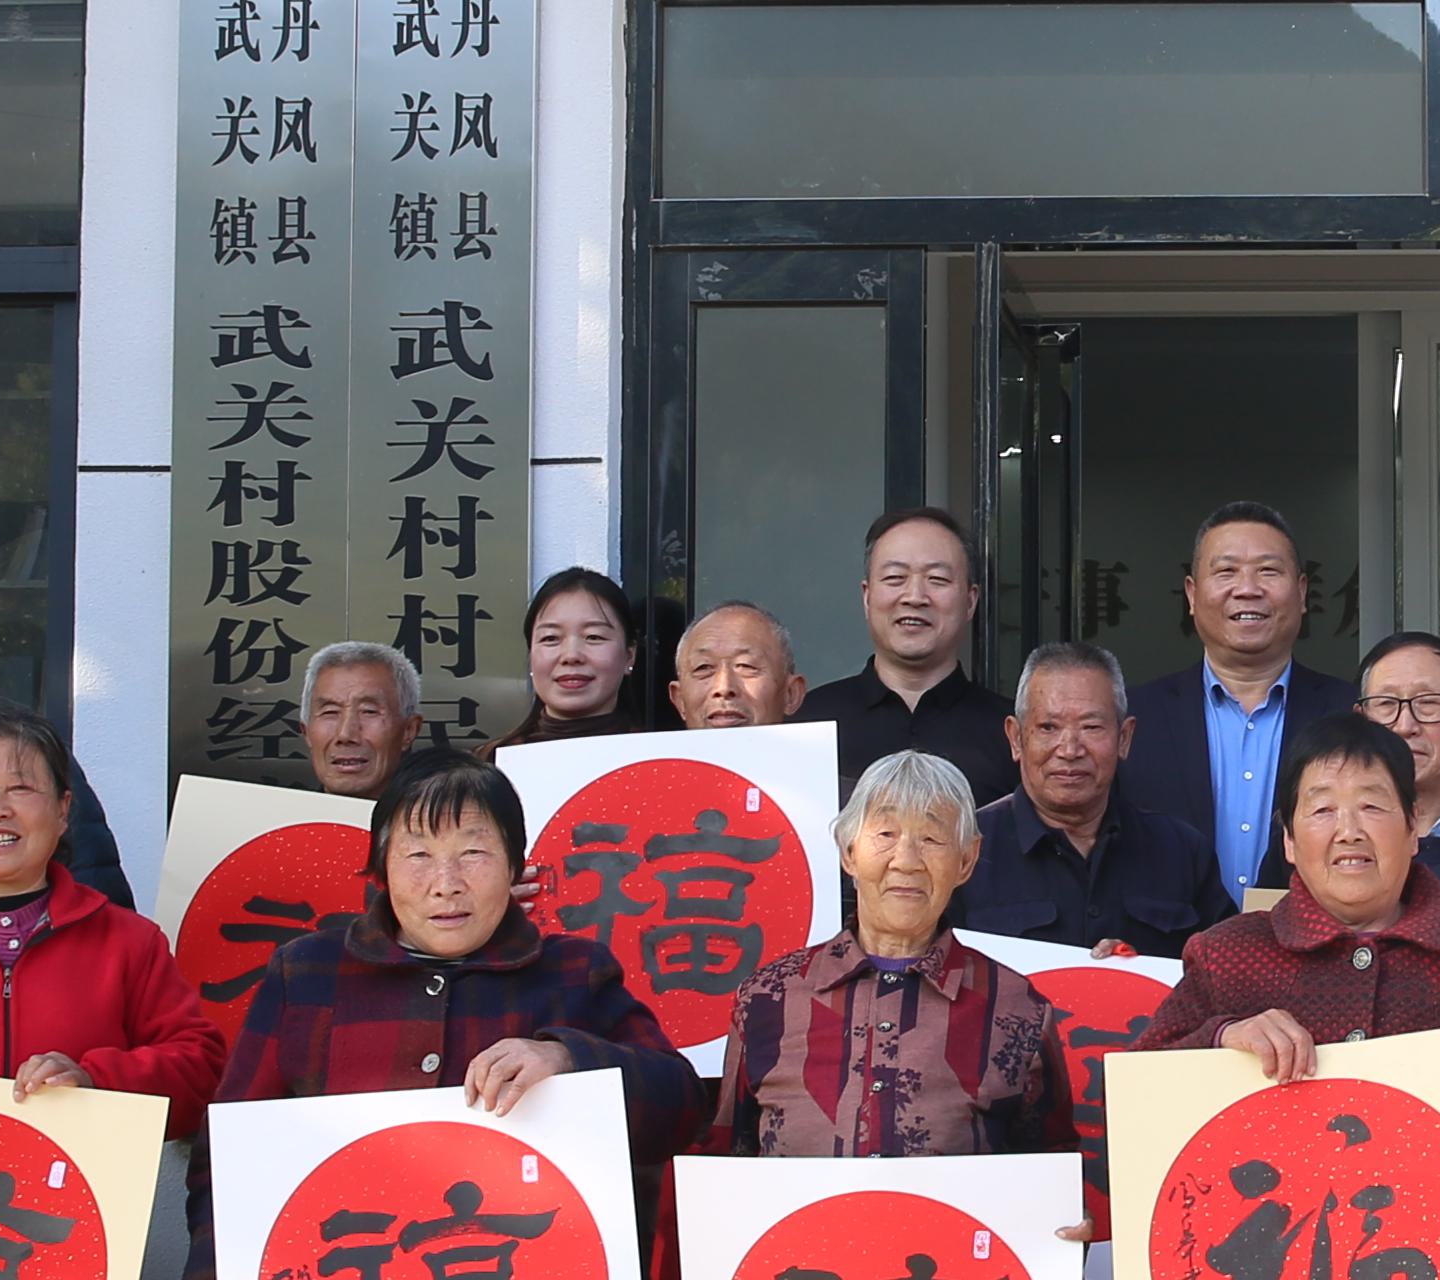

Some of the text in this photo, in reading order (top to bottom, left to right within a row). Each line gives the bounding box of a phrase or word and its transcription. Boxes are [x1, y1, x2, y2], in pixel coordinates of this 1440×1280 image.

[203, 304, 315, 790] 武关村股份经
[555, 808, 785, 998] 福
